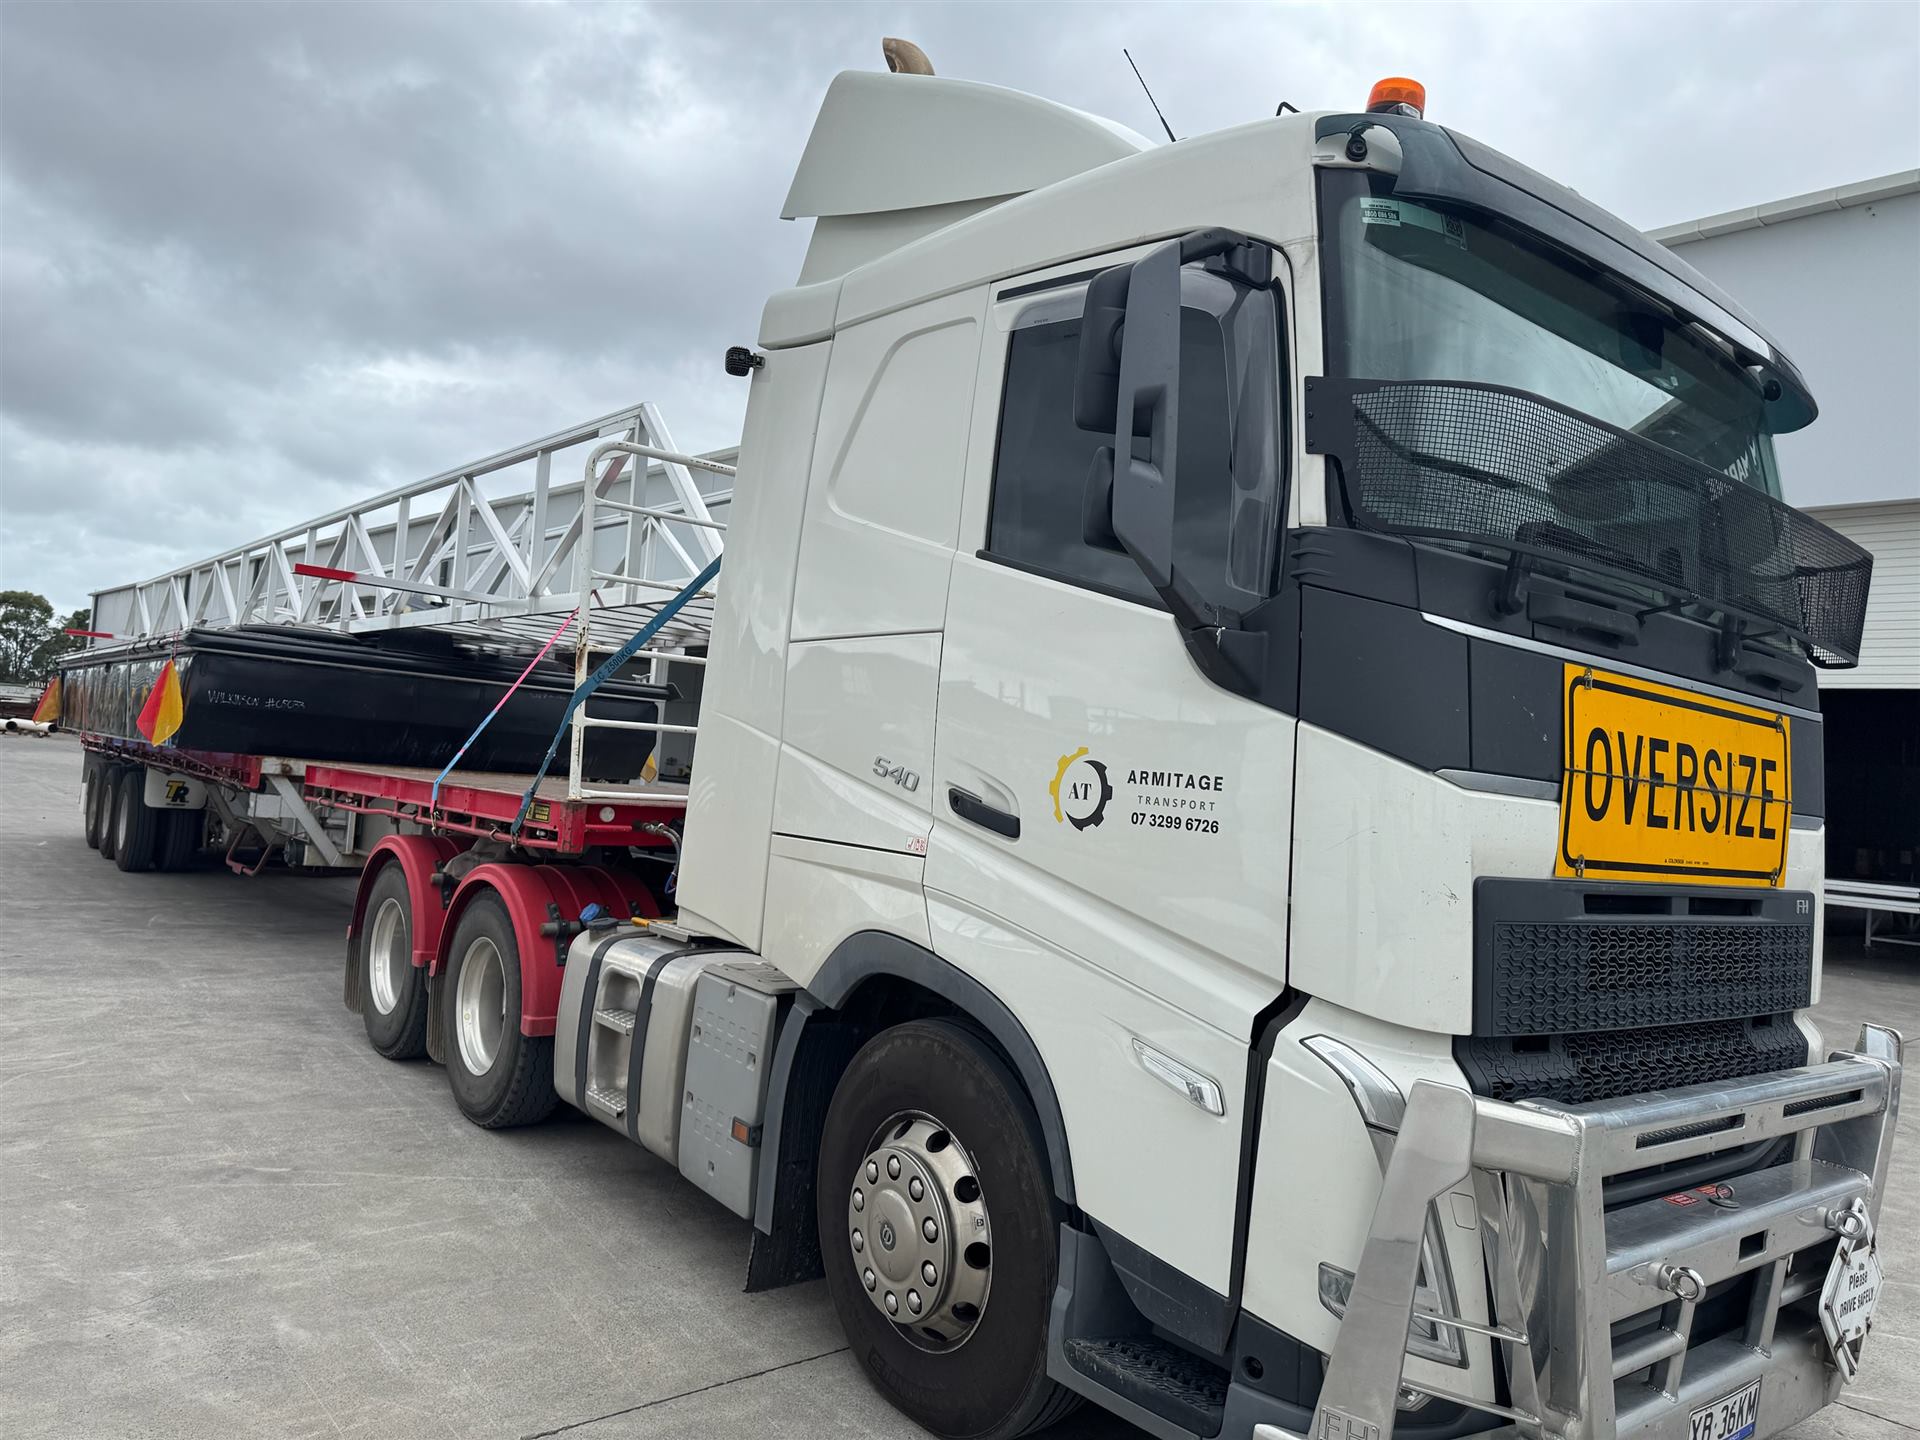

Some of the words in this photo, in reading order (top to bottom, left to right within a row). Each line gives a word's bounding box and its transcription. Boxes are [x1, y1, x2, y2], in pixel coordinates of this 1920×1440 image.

[607, 645, 634, 674] 2500KG
[872, 755, 920, 792] 540
[1127, 769, 1225, 792] ARMITAGE
[1584, 727, 1777, 840] OVERSIZE
[1068, 782, 1093, 800] AT
[1137, 795, 1217, 812] TRANSPORT
[1131, 811, 1147, 826] 07
[1149, 814, 1182, 830] 3299
[1185, 817, 1220, 834] 6726
[1796, 899, 1809, 914] FH
[1848, 1270, 1868, 1292] Please
[1839, 1296, 1857, 1318] DRIVE
[1857, 1286, 1875, 1310] SAFELY
